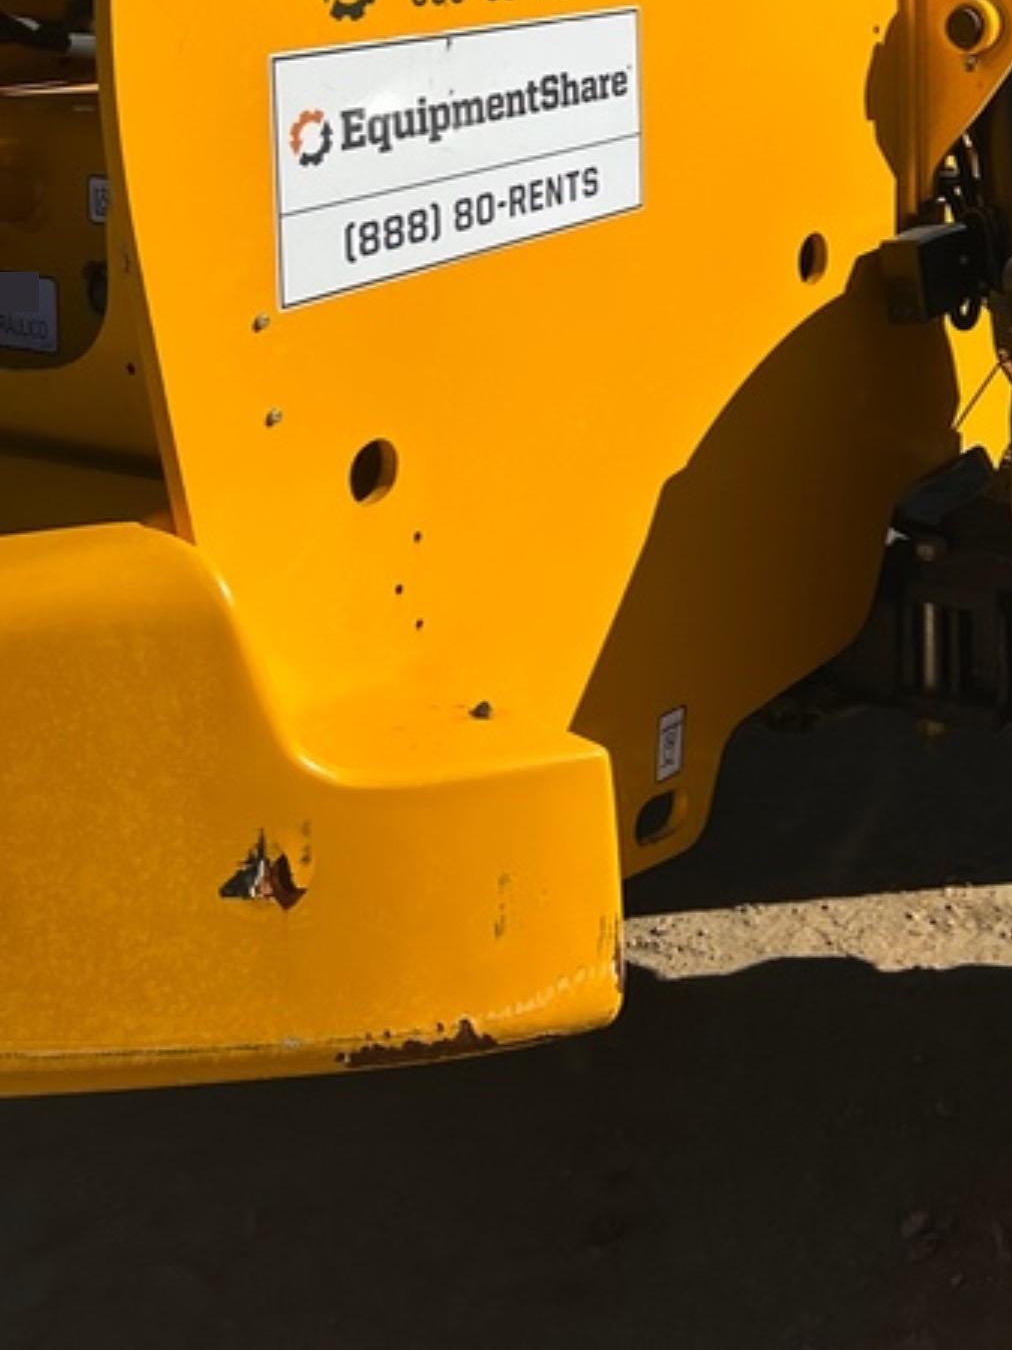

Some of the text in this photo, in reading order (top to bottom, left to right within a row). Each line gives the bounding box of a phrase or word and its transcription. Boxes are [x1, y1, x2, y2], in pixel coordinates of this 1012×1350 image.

[340, 69, 628, 153] EquipmentShare
[345, 167, 599, 263] (888) 80-RENTS
